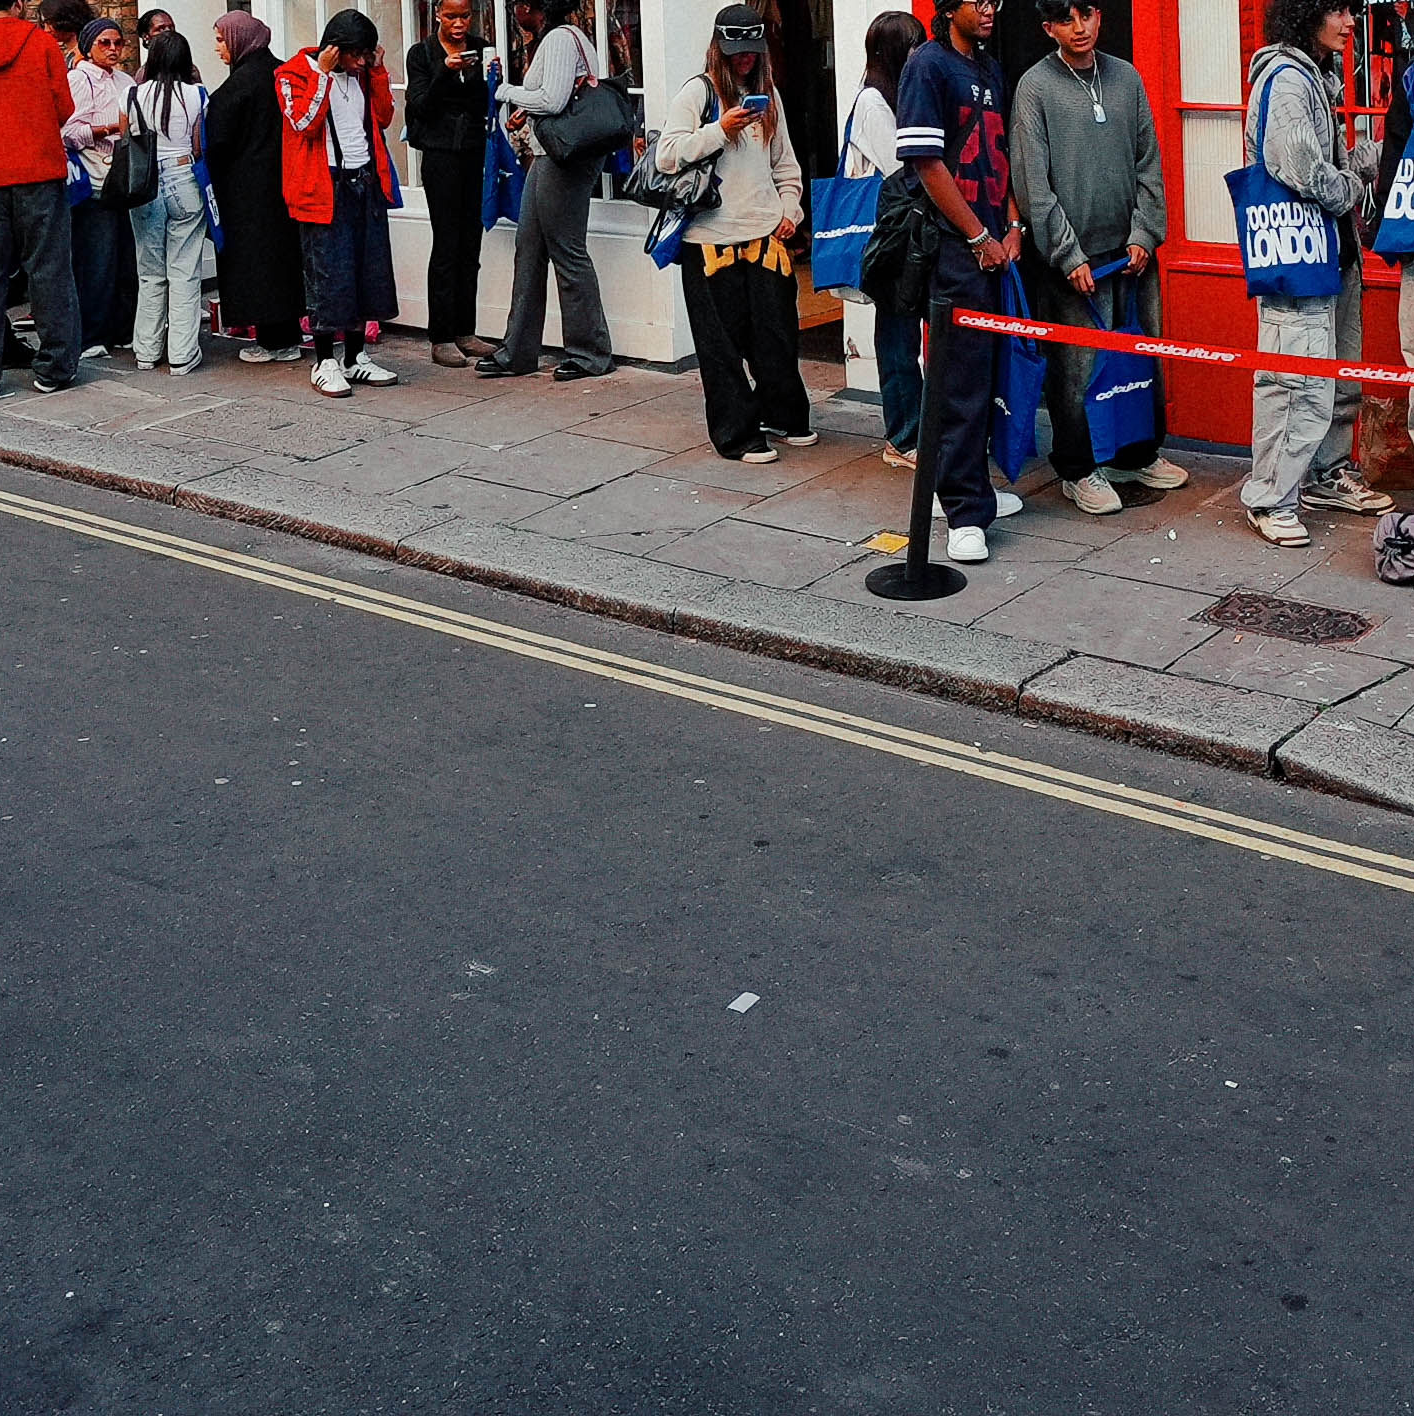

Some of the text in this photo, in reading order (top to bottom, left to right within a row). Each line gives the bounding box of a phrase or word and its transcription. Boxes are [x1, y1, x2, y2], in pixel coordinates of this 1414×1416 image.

[1396, 158, 1414, 183] LD
[1246, 204, 1269, 231] TOO
[1269, 202, 1304, 228] COLD
[1247, 226, 1328, 269] LONDON
